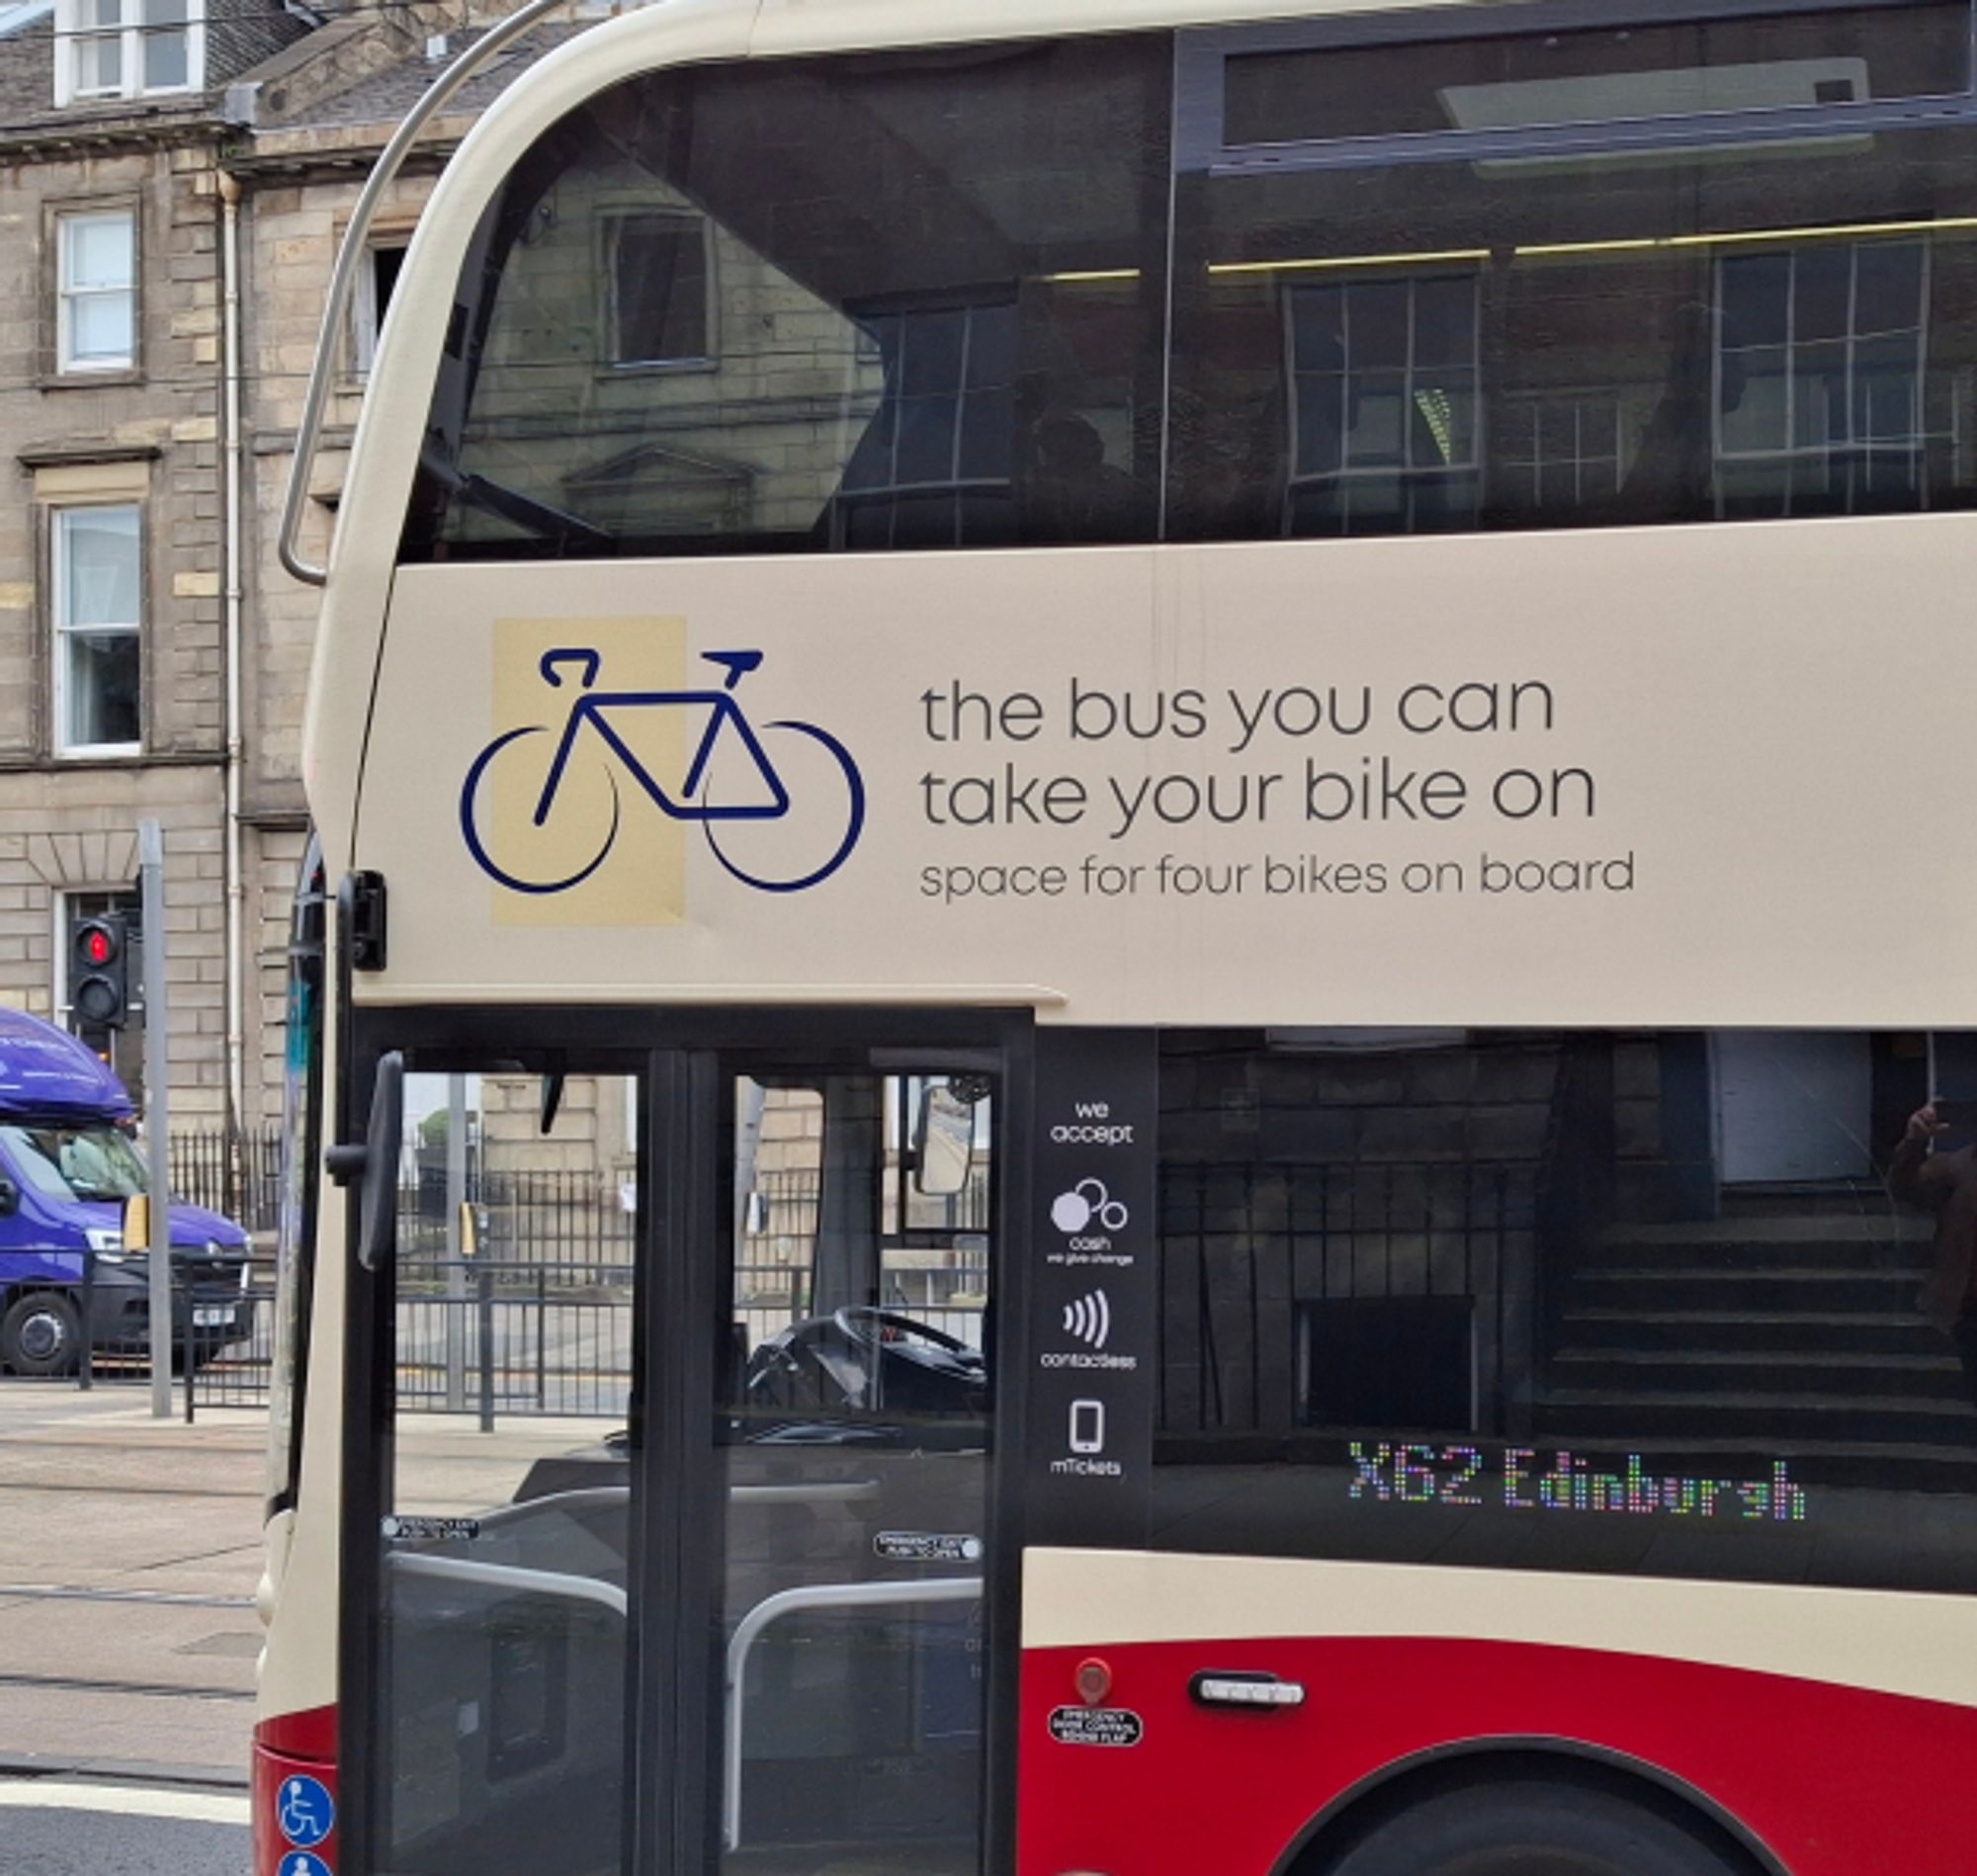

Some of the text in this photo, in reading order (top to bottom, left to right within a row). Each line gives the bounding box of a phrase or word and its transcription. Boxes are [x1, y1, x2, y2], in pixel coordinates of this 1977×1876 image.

[920, 677, 1553, 753] the bus you can
[919, 756, 1594, 839] take your bike on
[920, 850, 1634, 904] space for four bikes on board
[1074, 1102, 1109, 1119] we
[1050, 1125, 1135, 1147] accept
[1069, 1236, 1112, 1251] cash
[1040, 1352, 1137, 1370] contactless
[1050, 1457, 1122, 1476] mTickets
[1348, 1441, 1806, 1521] X62 Edinburgh
